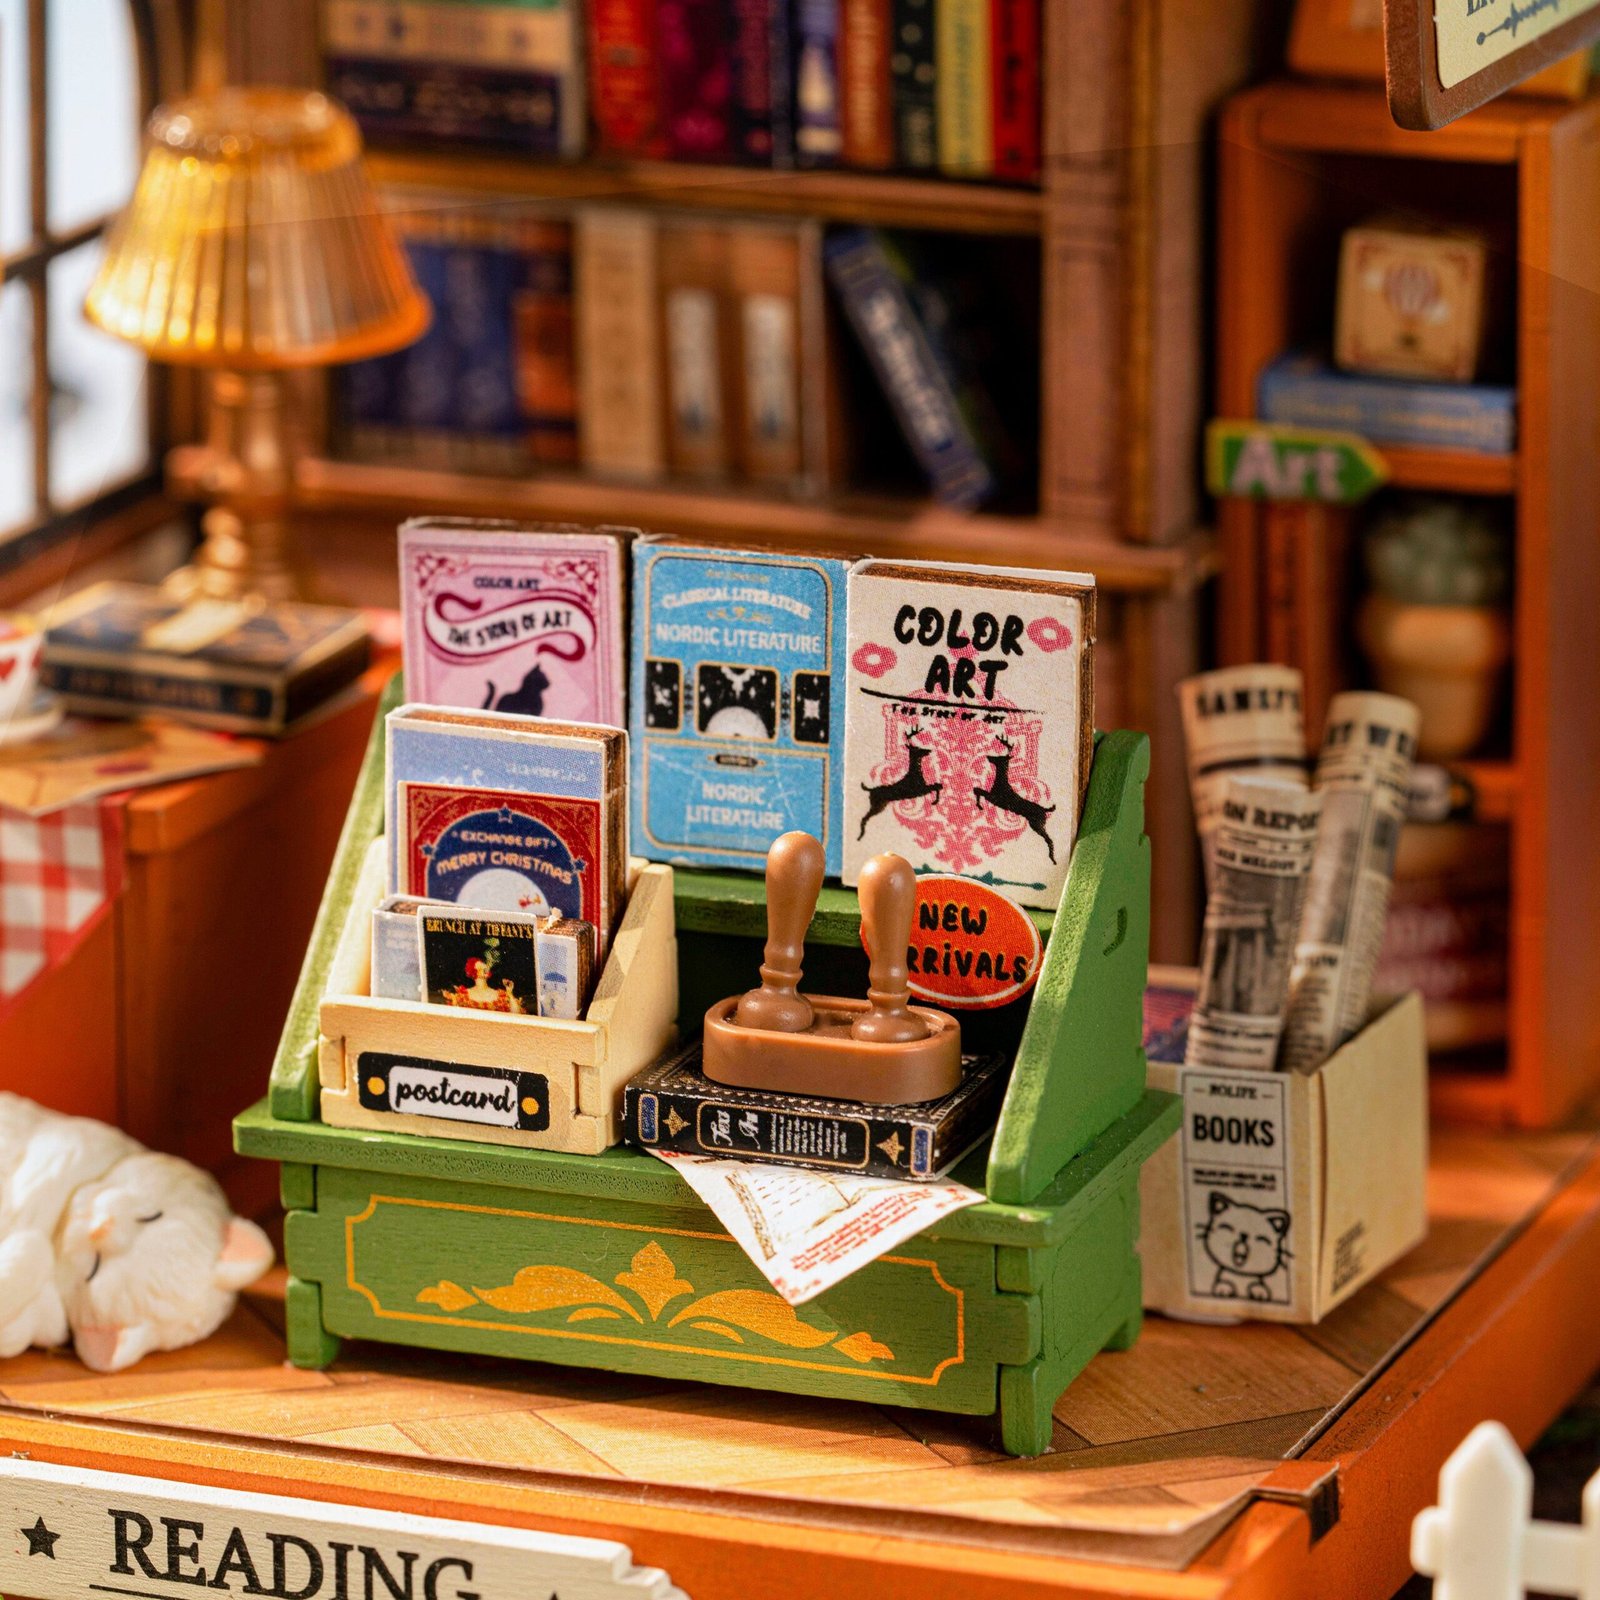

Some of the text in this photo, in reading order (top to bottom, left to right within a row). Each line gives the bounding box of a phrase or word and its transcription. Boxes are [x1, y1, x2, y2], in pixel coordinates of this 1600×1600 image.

[1230, 431, 1340, 498] Art
[516, 578, 541, 590] ART
[522, 611, 537, 630] OF
[542, 611, 572, 629] ART
[893, 604, 1025, 656] COLOR
[655, 623, 822, 654] NORDIC LITERATURE
[924, 654, 1009, 700] ART
[891, 703, 1006, 724] THE STORY OF ART
[702, 781, 766, 805] NORDIC
[686, 804, 784, 830] LITERATURE
[460, 829, 550, 849] EXCHANGE GIFT
[436, 852, 573, 885] MERRY CHRISTMAS
[469, 921, 482, 935] AT
[919, 902, 988, 936] NEW
[906, 942, 1028, 984] RRiVALS
[395, 1077, 516, 1113] postcard
[1193, 1113, 1275, 1147] BOOKS
[108, 1508, 481, 1600] READING
